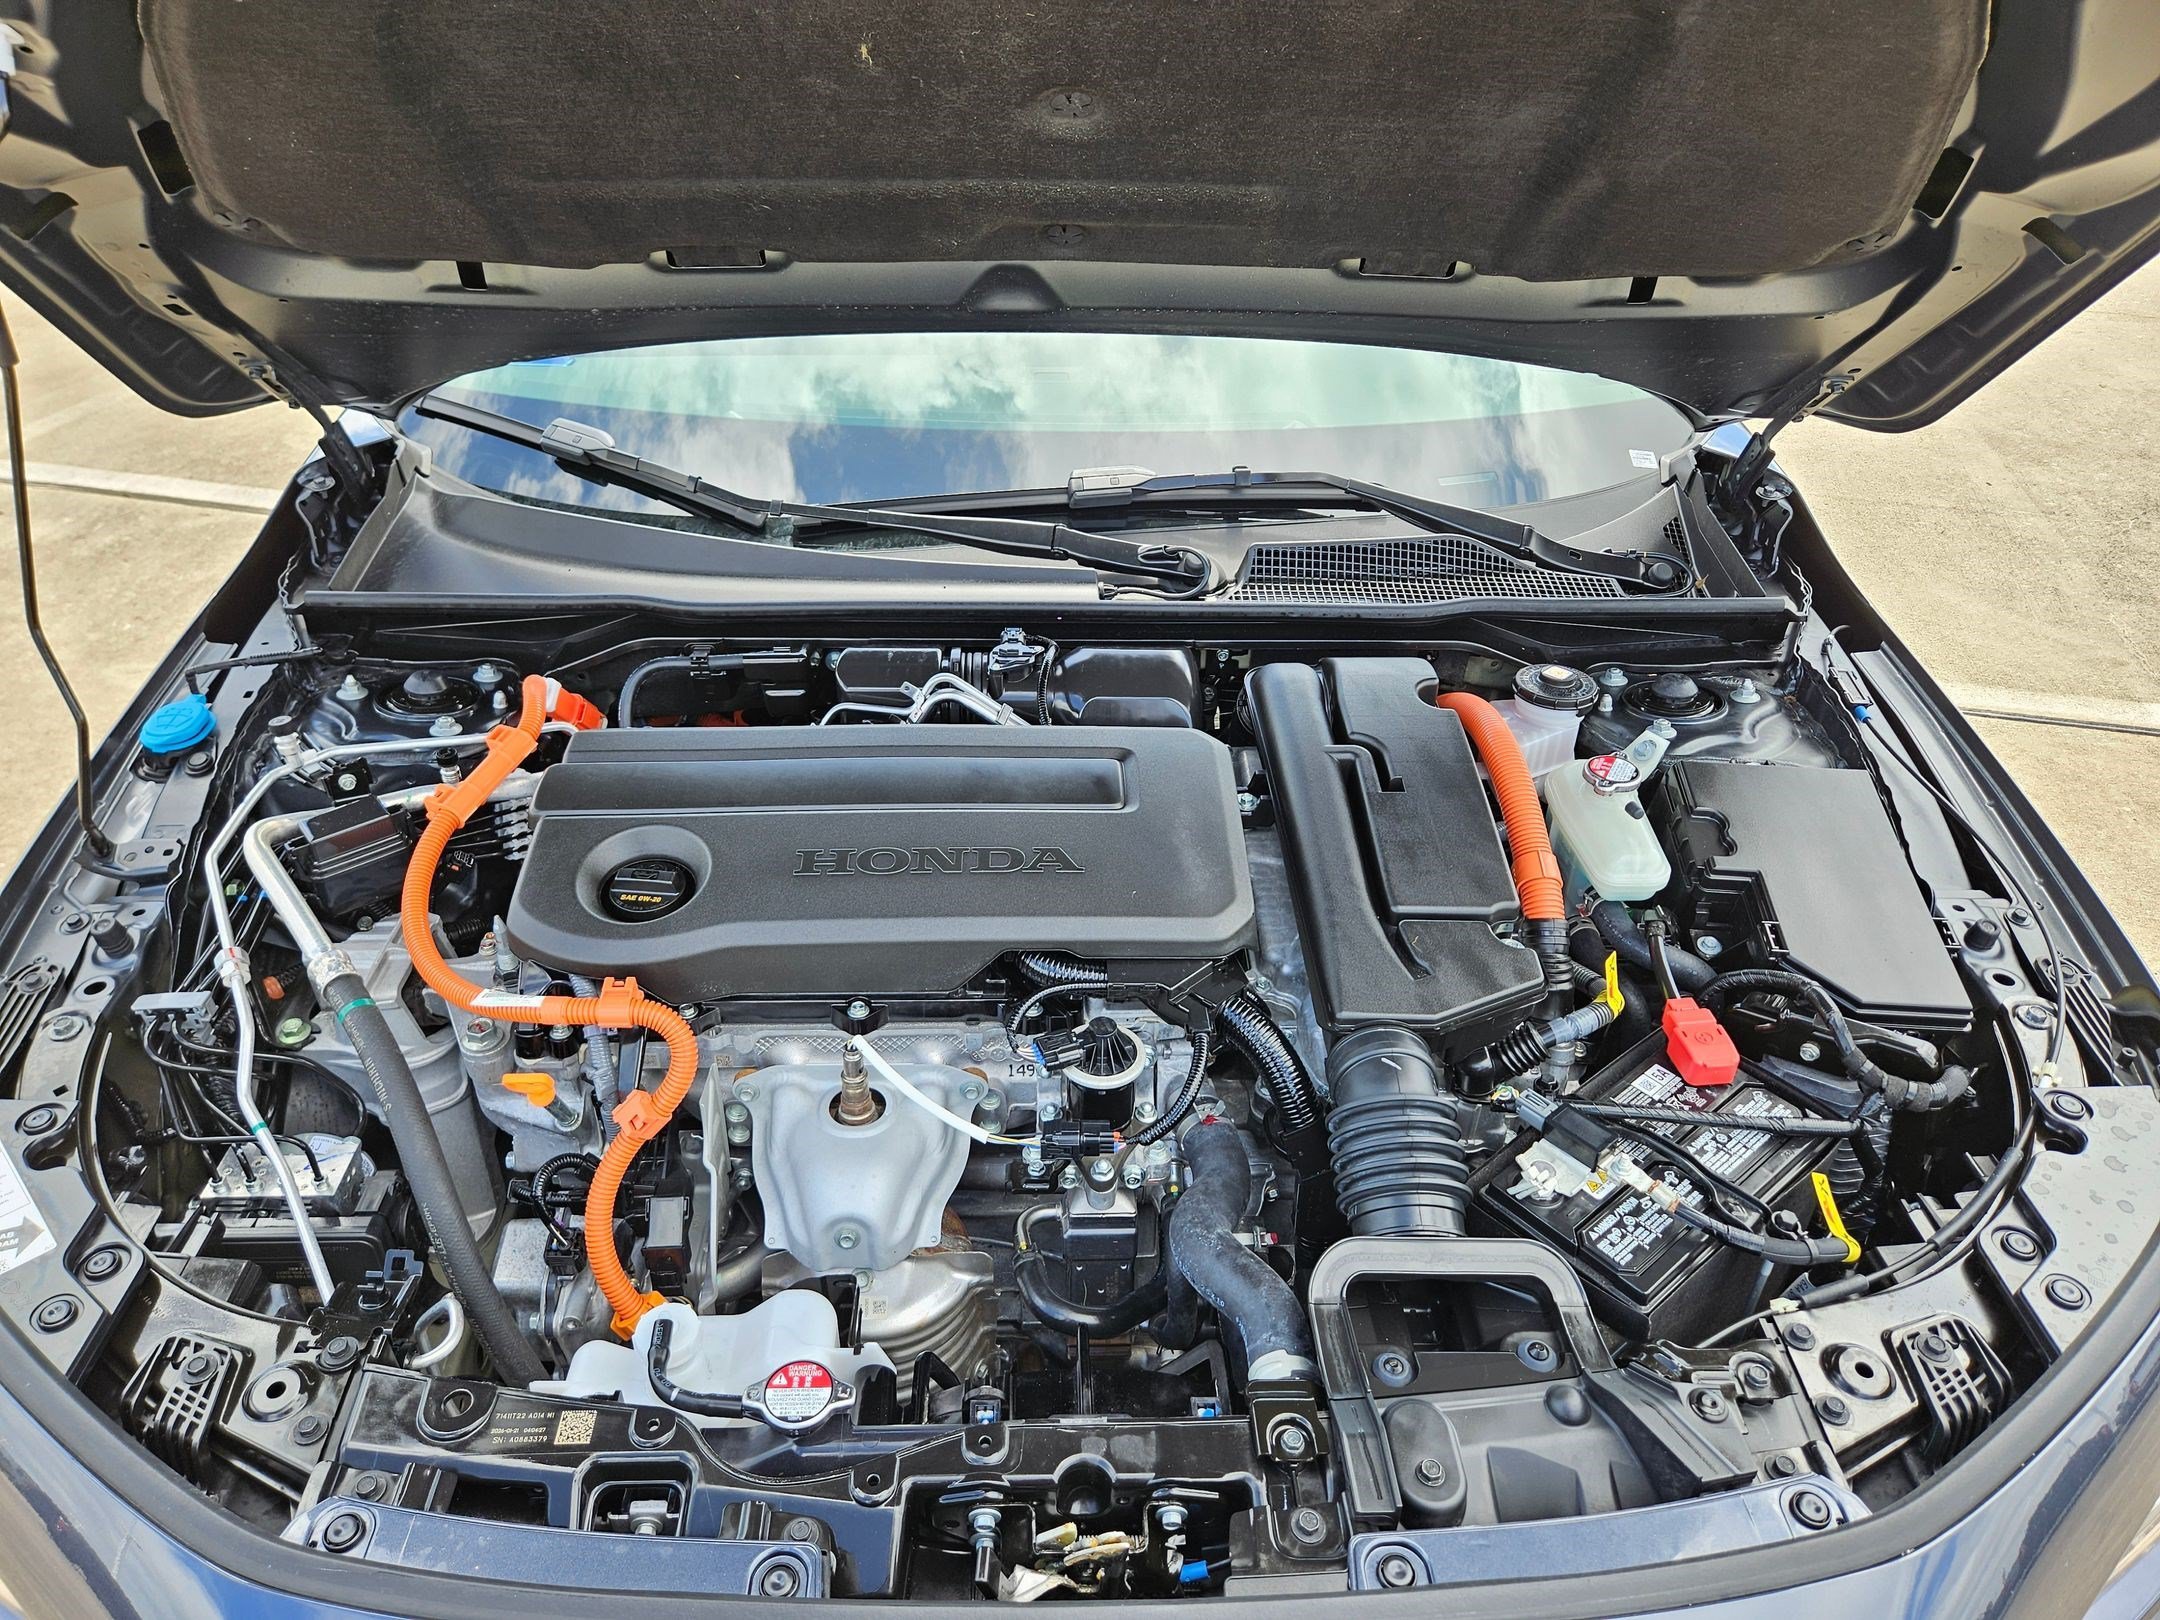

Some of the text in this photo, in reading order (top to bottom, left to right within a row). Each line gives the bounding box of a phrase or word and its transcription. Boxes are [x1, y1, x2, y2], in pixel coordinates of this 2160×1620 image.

[793, 847, 1086, 875] HONDA
[1008, 1064, 1035, 1077] 149
[1653, 1068, 1671, 1082] 5A
[366, 1057, 392, 1112] S-NICHIRIN
